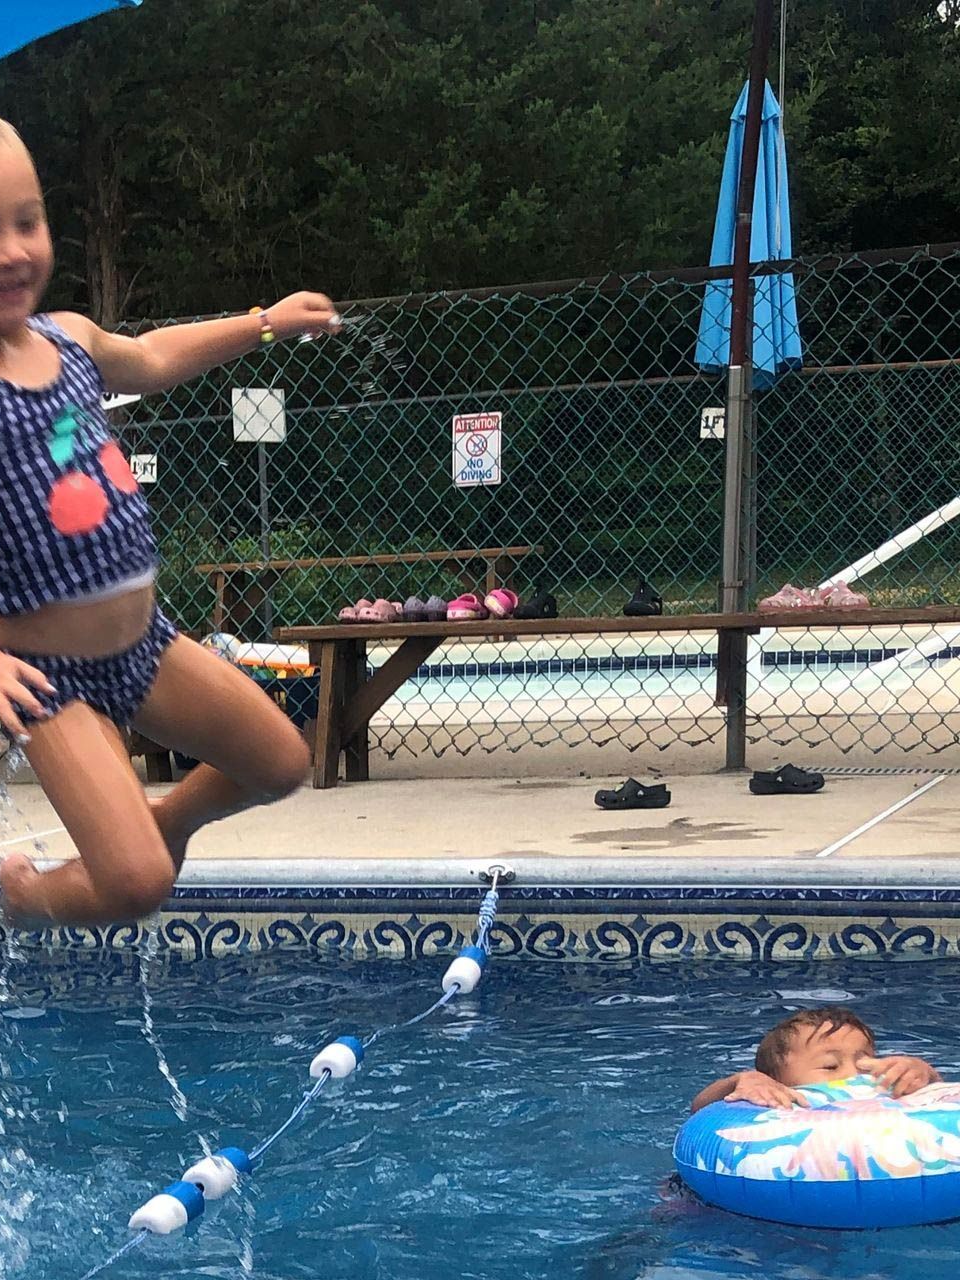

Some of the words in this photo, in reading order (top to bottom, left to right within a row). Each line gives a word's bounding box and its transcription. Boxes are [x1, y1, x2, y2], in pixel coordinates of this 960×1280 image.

[456, 418, 499, 431] ATTENTION
[468, 459, 484, 468] NO
[461, 470, 493, 481] DIVING
